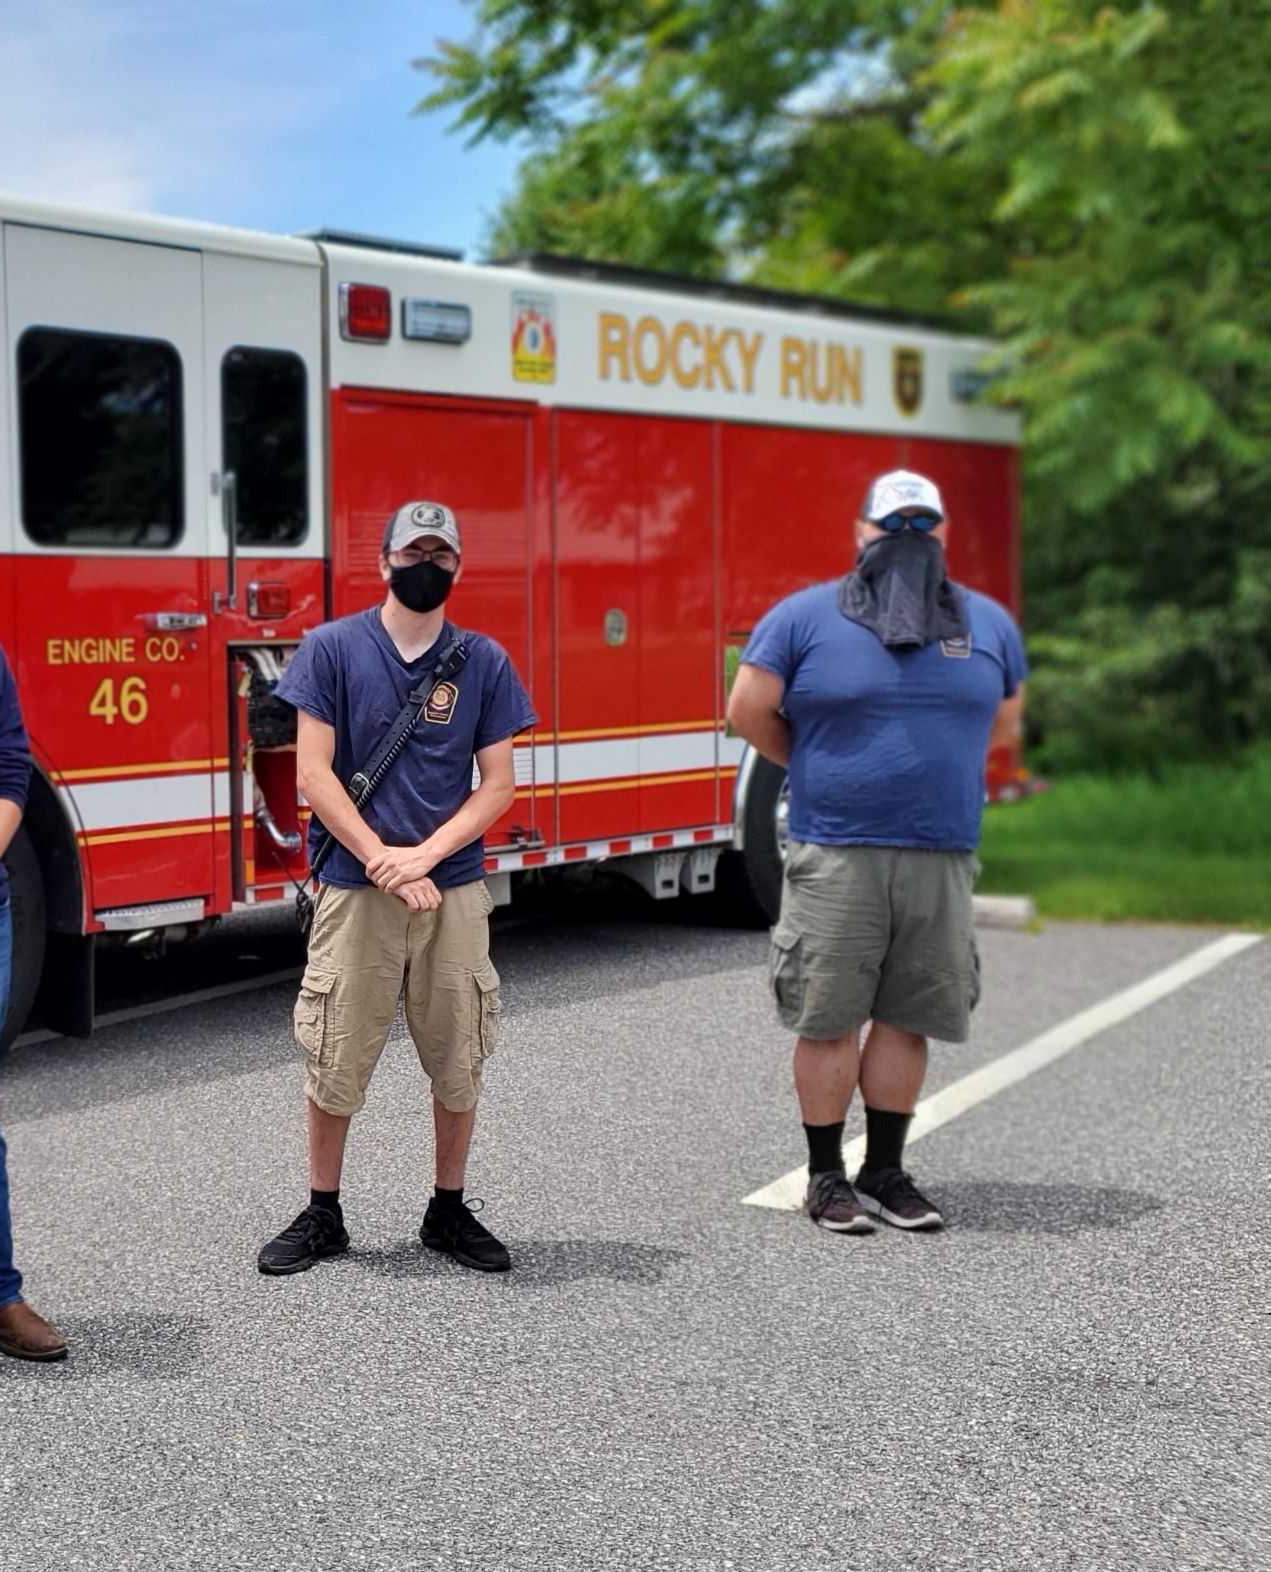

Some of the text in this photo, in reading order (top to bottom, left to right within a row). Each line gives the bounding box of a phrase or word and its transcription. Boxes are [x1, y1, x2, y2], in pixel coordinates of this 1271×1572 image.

[598, 312, 864, 407] ROCKY RUN
[47, 637, 185, 665] ENGINE CO.
[88, 675, 149, 725] 46
